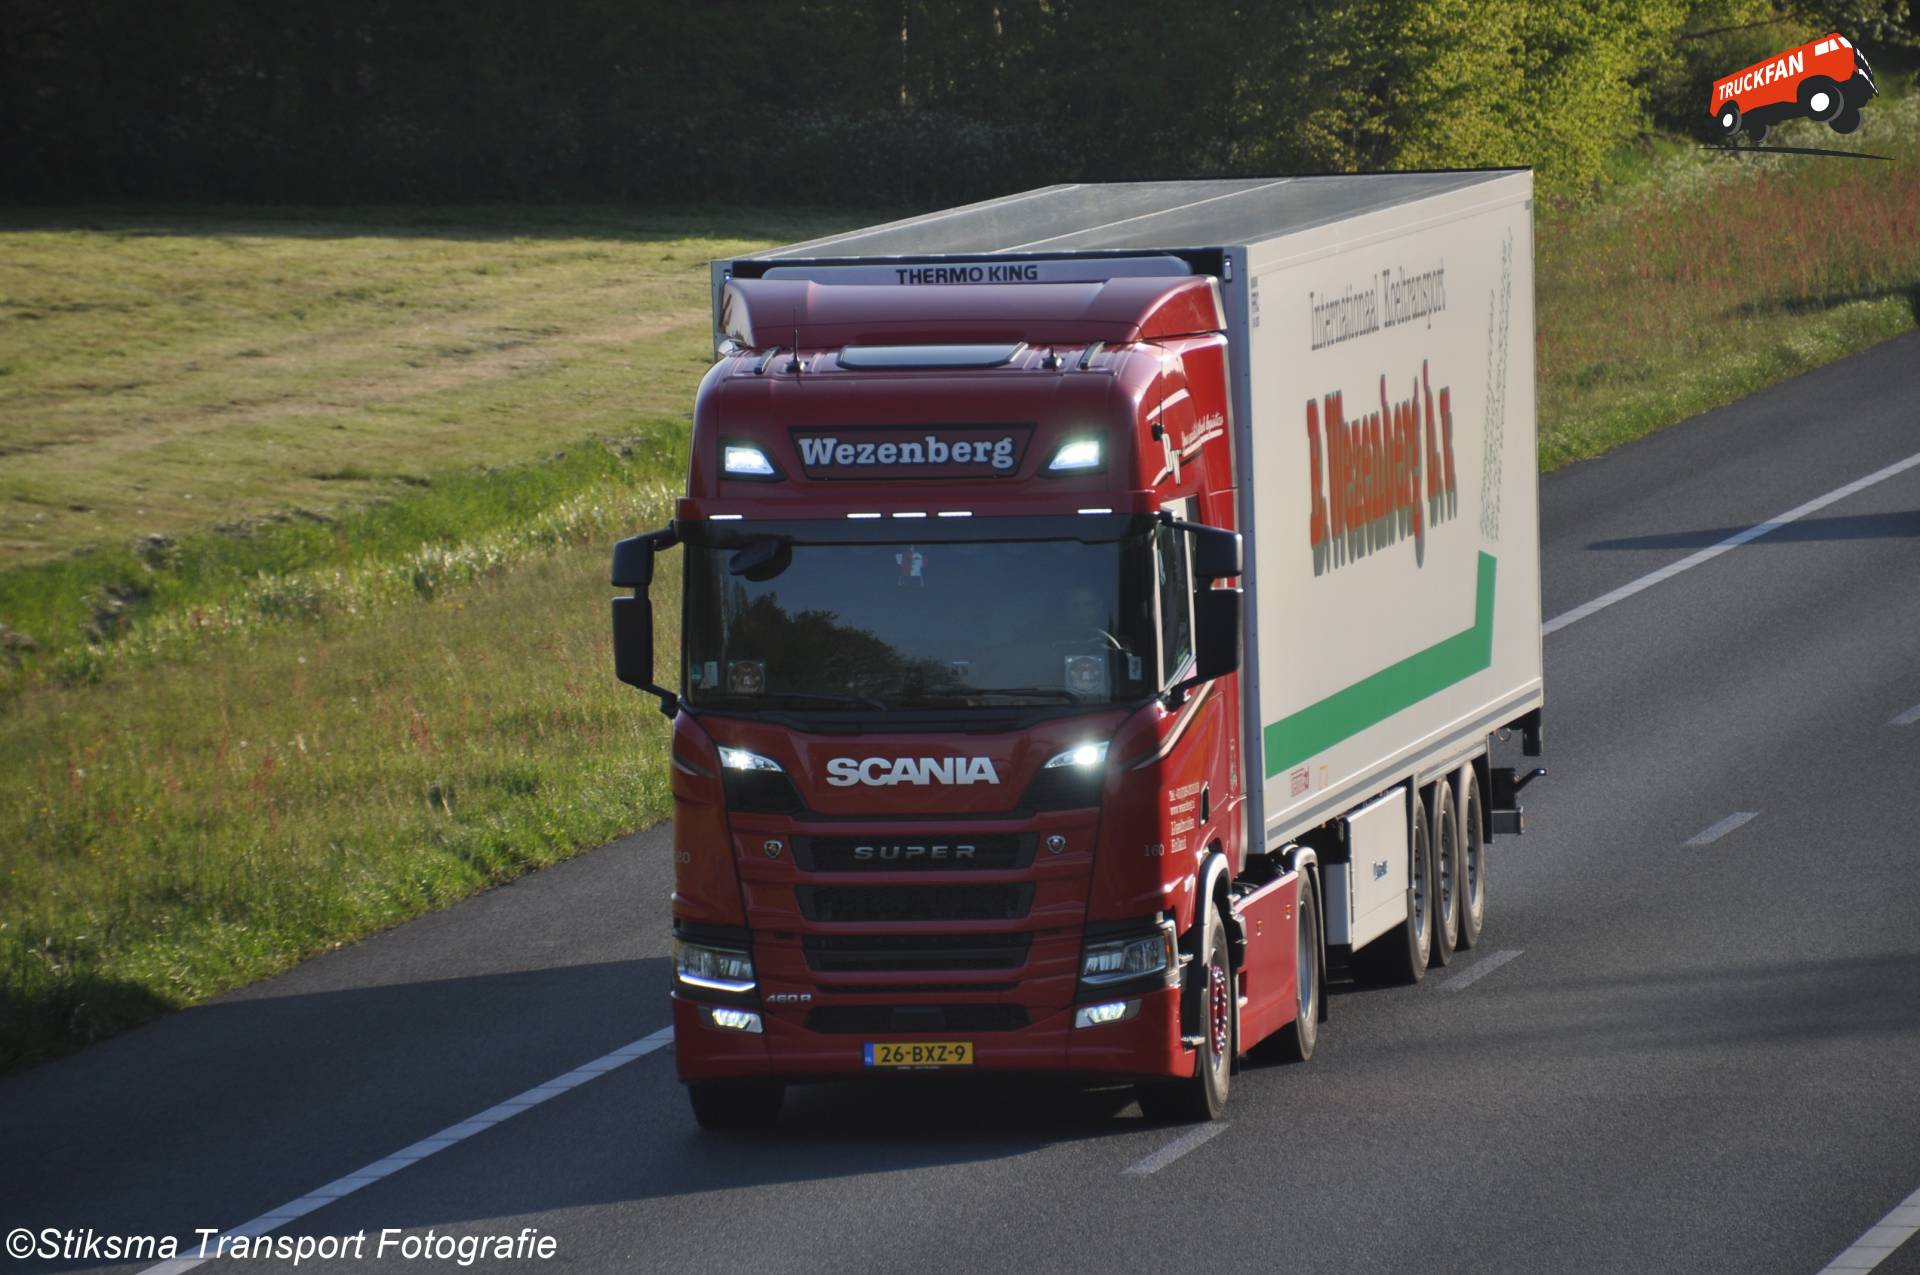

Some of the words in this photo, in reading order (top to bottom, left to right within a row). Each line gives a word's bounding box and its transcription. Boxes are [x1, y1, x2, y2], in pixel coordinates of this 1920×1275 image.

[896, 267, 983, 284] THERMO
[988, 265, 1038, 282] KING
[799, 436, 1014, 469] Wezenberg
[826, 756, 999, 787] SCANIA
[853, 845, 976, 860] SUPER
[881, 1045, 965, 1063] 26-BXZ-9
